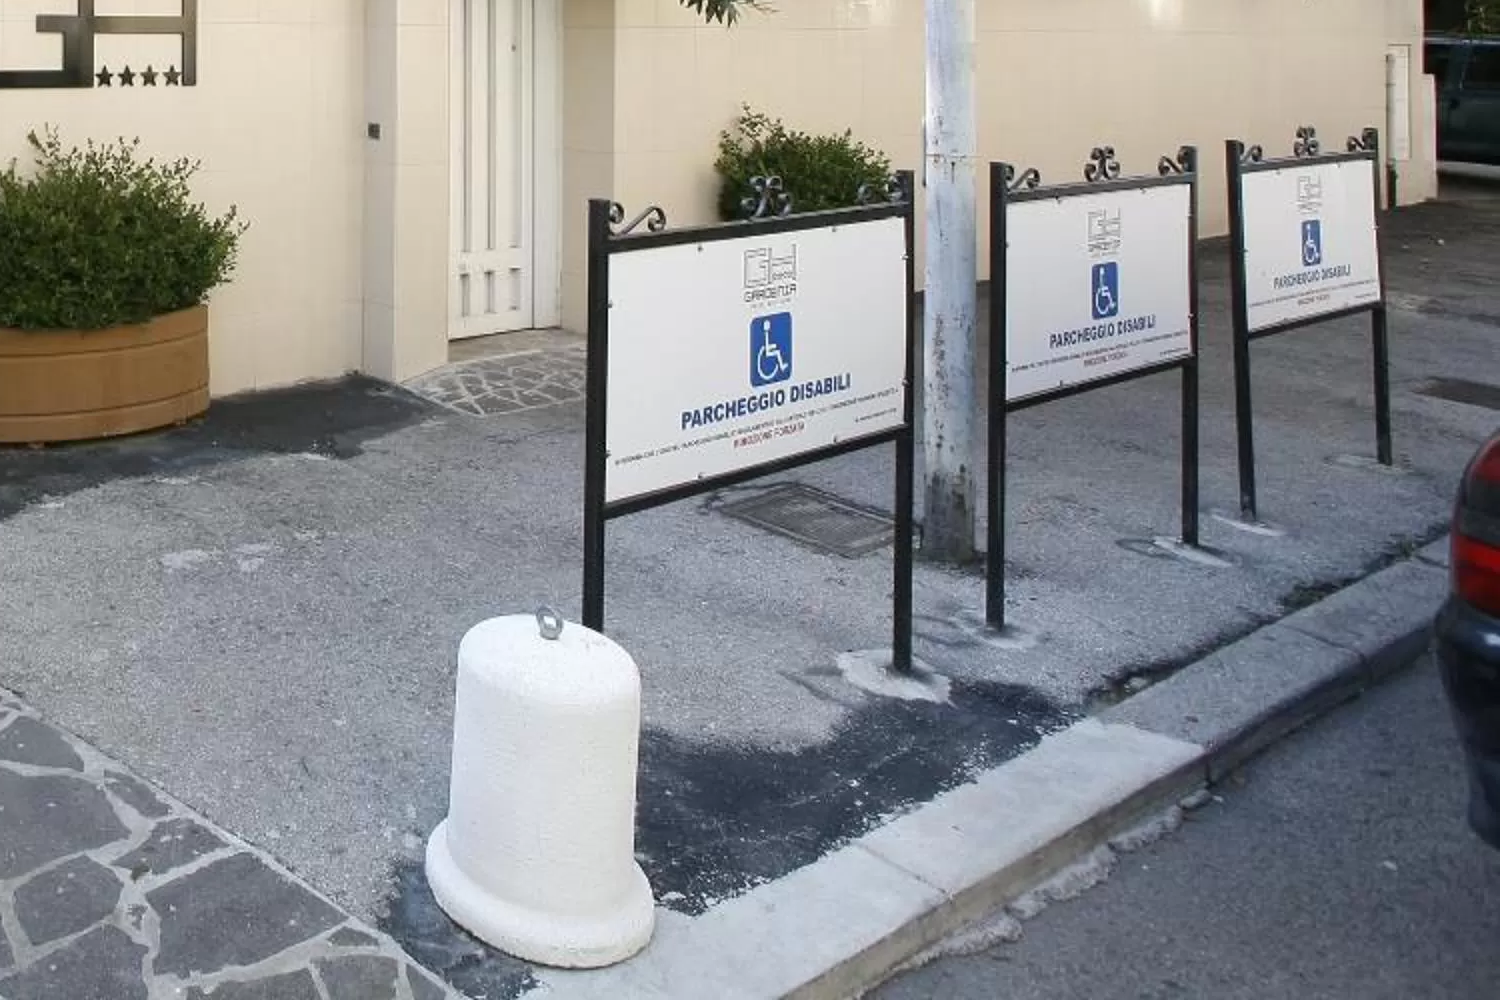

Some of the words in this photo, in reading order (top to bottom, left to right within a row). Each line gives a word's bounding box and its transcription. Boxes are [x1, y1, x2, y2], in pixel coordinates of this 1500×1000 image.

[1049, 323, 1115, 349] PARCHEGGIO
[1118, 314, 1156, 336] DISABILI
[681, 389, 785, 430] PARCHEGGIO
[791, 373, 851, 403] DISABILI
